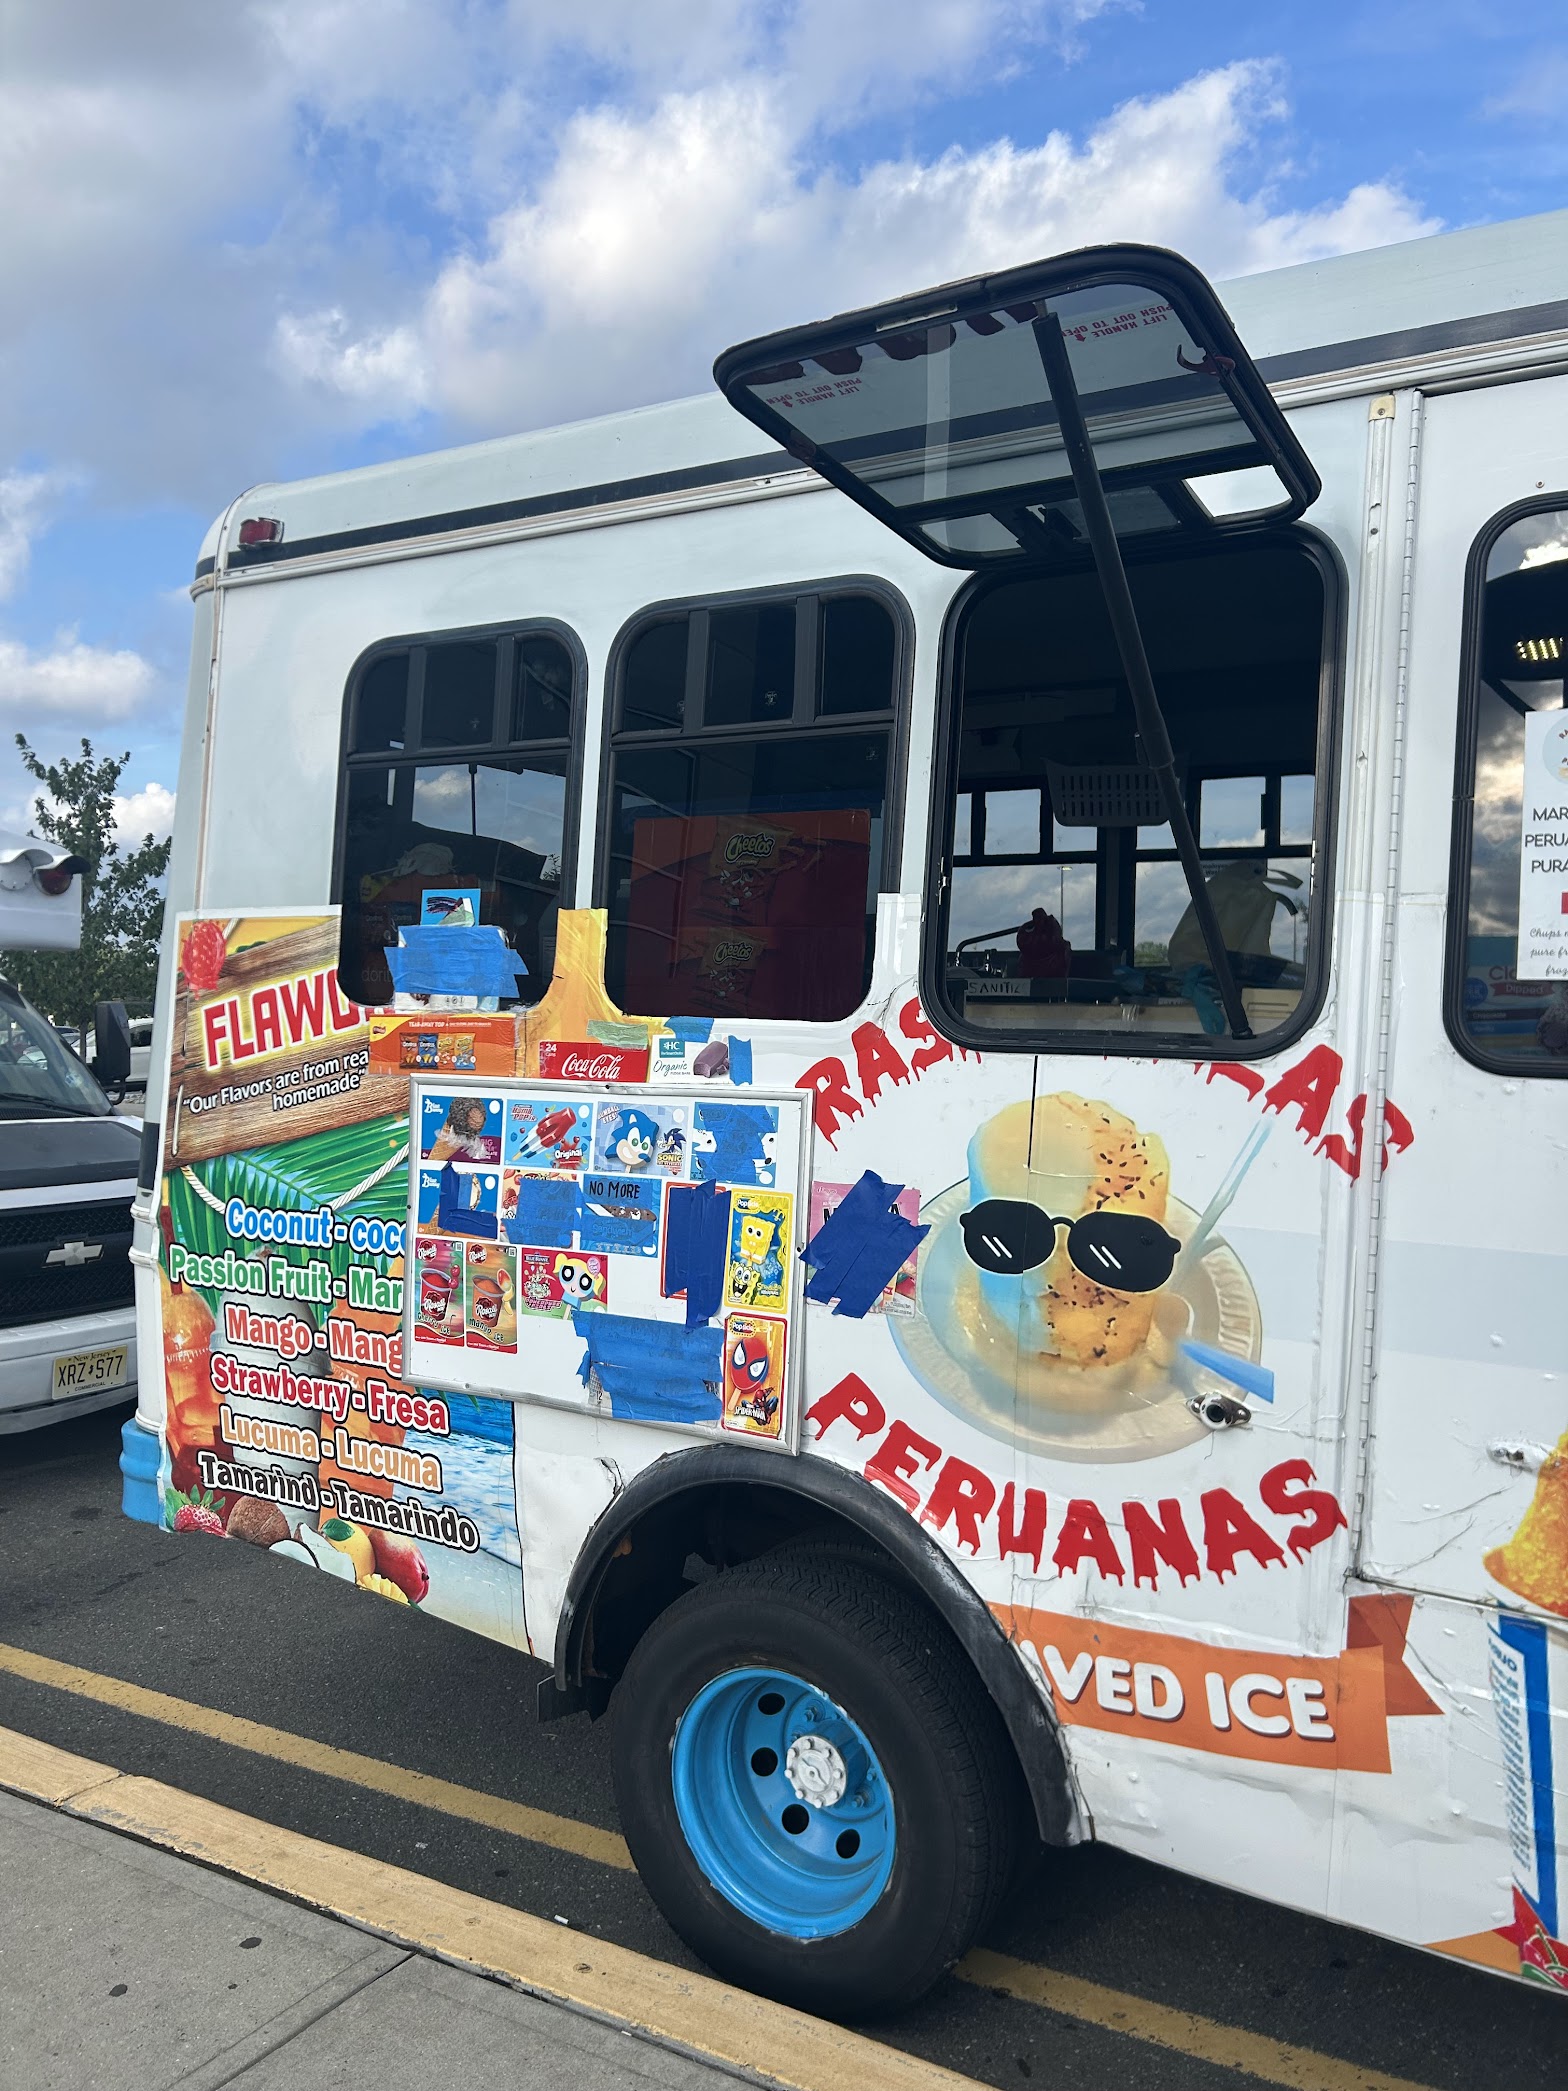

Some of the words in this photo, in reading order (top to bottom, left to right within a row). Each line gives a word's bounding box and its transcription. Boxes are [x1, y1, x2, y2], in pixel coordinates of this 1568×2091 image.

[1092, 320, 1109, 329] TO
[1113, 312, 1136, 324] OUT
[1143, 314, 1167, 326] LIFT
[1091, 321, 1138, 338] HANDLE
[796, 391, 836, 404] HANDLE
[725, 832, 775, 863] Cheetos
[713, 941, 753, 965] Cheetos
[1505, 984, 1545, 994] Dipped
[546, 1043, 557, 1051] 24
[561, 1053, 624, 1080] Coca-Cola
[653, 1060, 688, 1077] Organic
[221, 1077, 272, 1105] Flavors
[275, 1070, 300, 1090] are
[303, 1057, 340, 1082] from
[554, 1149, 583, 1161] Original
[657, 1153, 682, 1162] SONIC
[589, 1181, 604, 1196] NO
[608, 1181, 641, 1199] MORE
[227, 1199, 331, 1245] Coconut
[171, 1246, 263, 1293] Passion
[269, 1259, 330, 1300] Fruit
[227, 1306, 311, 1356] Mango
[73, 1355, 90, 1363] New
[90, 1350, 111, 1361] Jersey
[58, 1362, 86, 1387] XRZ
[74, 1382, 106, 1392] COMMERCIAL
[212, 1356, 348, 1420] Strawberry
[369, 1383, 448, 1431] Fresa
[221, 1408, 319, 1459] Lucuma
[336, 1430, 440, 1488] Lucuma
[805, 1372, 1348, 1592] PERUANAS
[199, 1454, 318, 1508] Tamarind
[330, 1482, 478, 1551] Tamarindo
[1204, 1672, 1336, 1742] ICE
